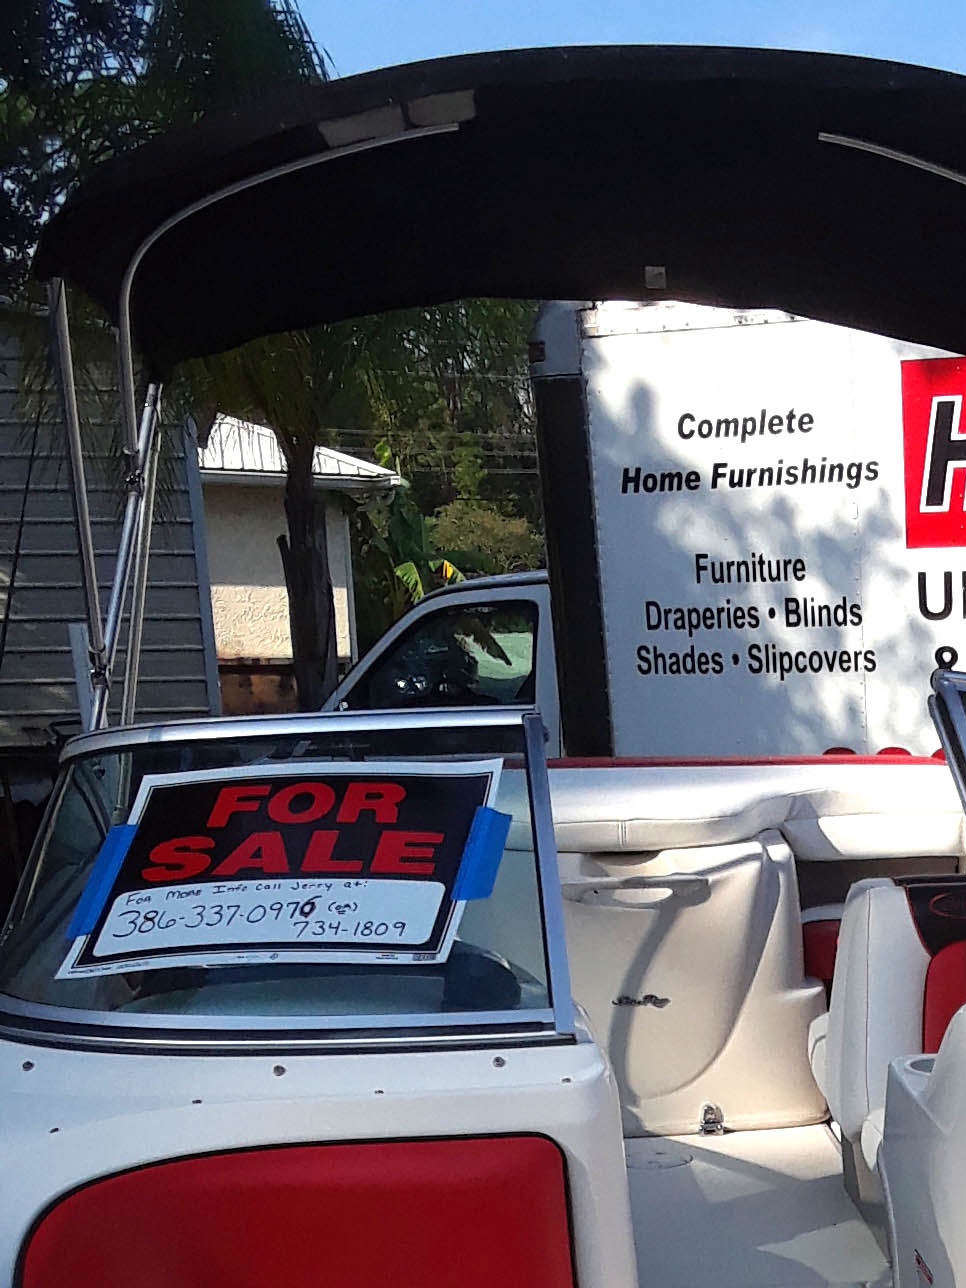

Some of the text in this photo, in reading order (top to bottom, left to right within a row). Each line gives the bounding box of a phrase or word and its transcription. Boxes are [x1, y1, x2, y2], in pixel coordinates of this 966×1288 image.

[677, 408, 814, 442] Complete
[621, 457, 879, 493] Home Furnishings
[695, 552, 806, 584] Furniture
[645, 597, 862, 637] Draperies Blinds
[637, 643, 877, 680] Shades Slipcovers
[206, 782, 406, 828] FOR
[141, 831, 445, 882] SALE
[290, 881, 333, 892] Jerry
[292, 920, 407, 939] 734-1809
